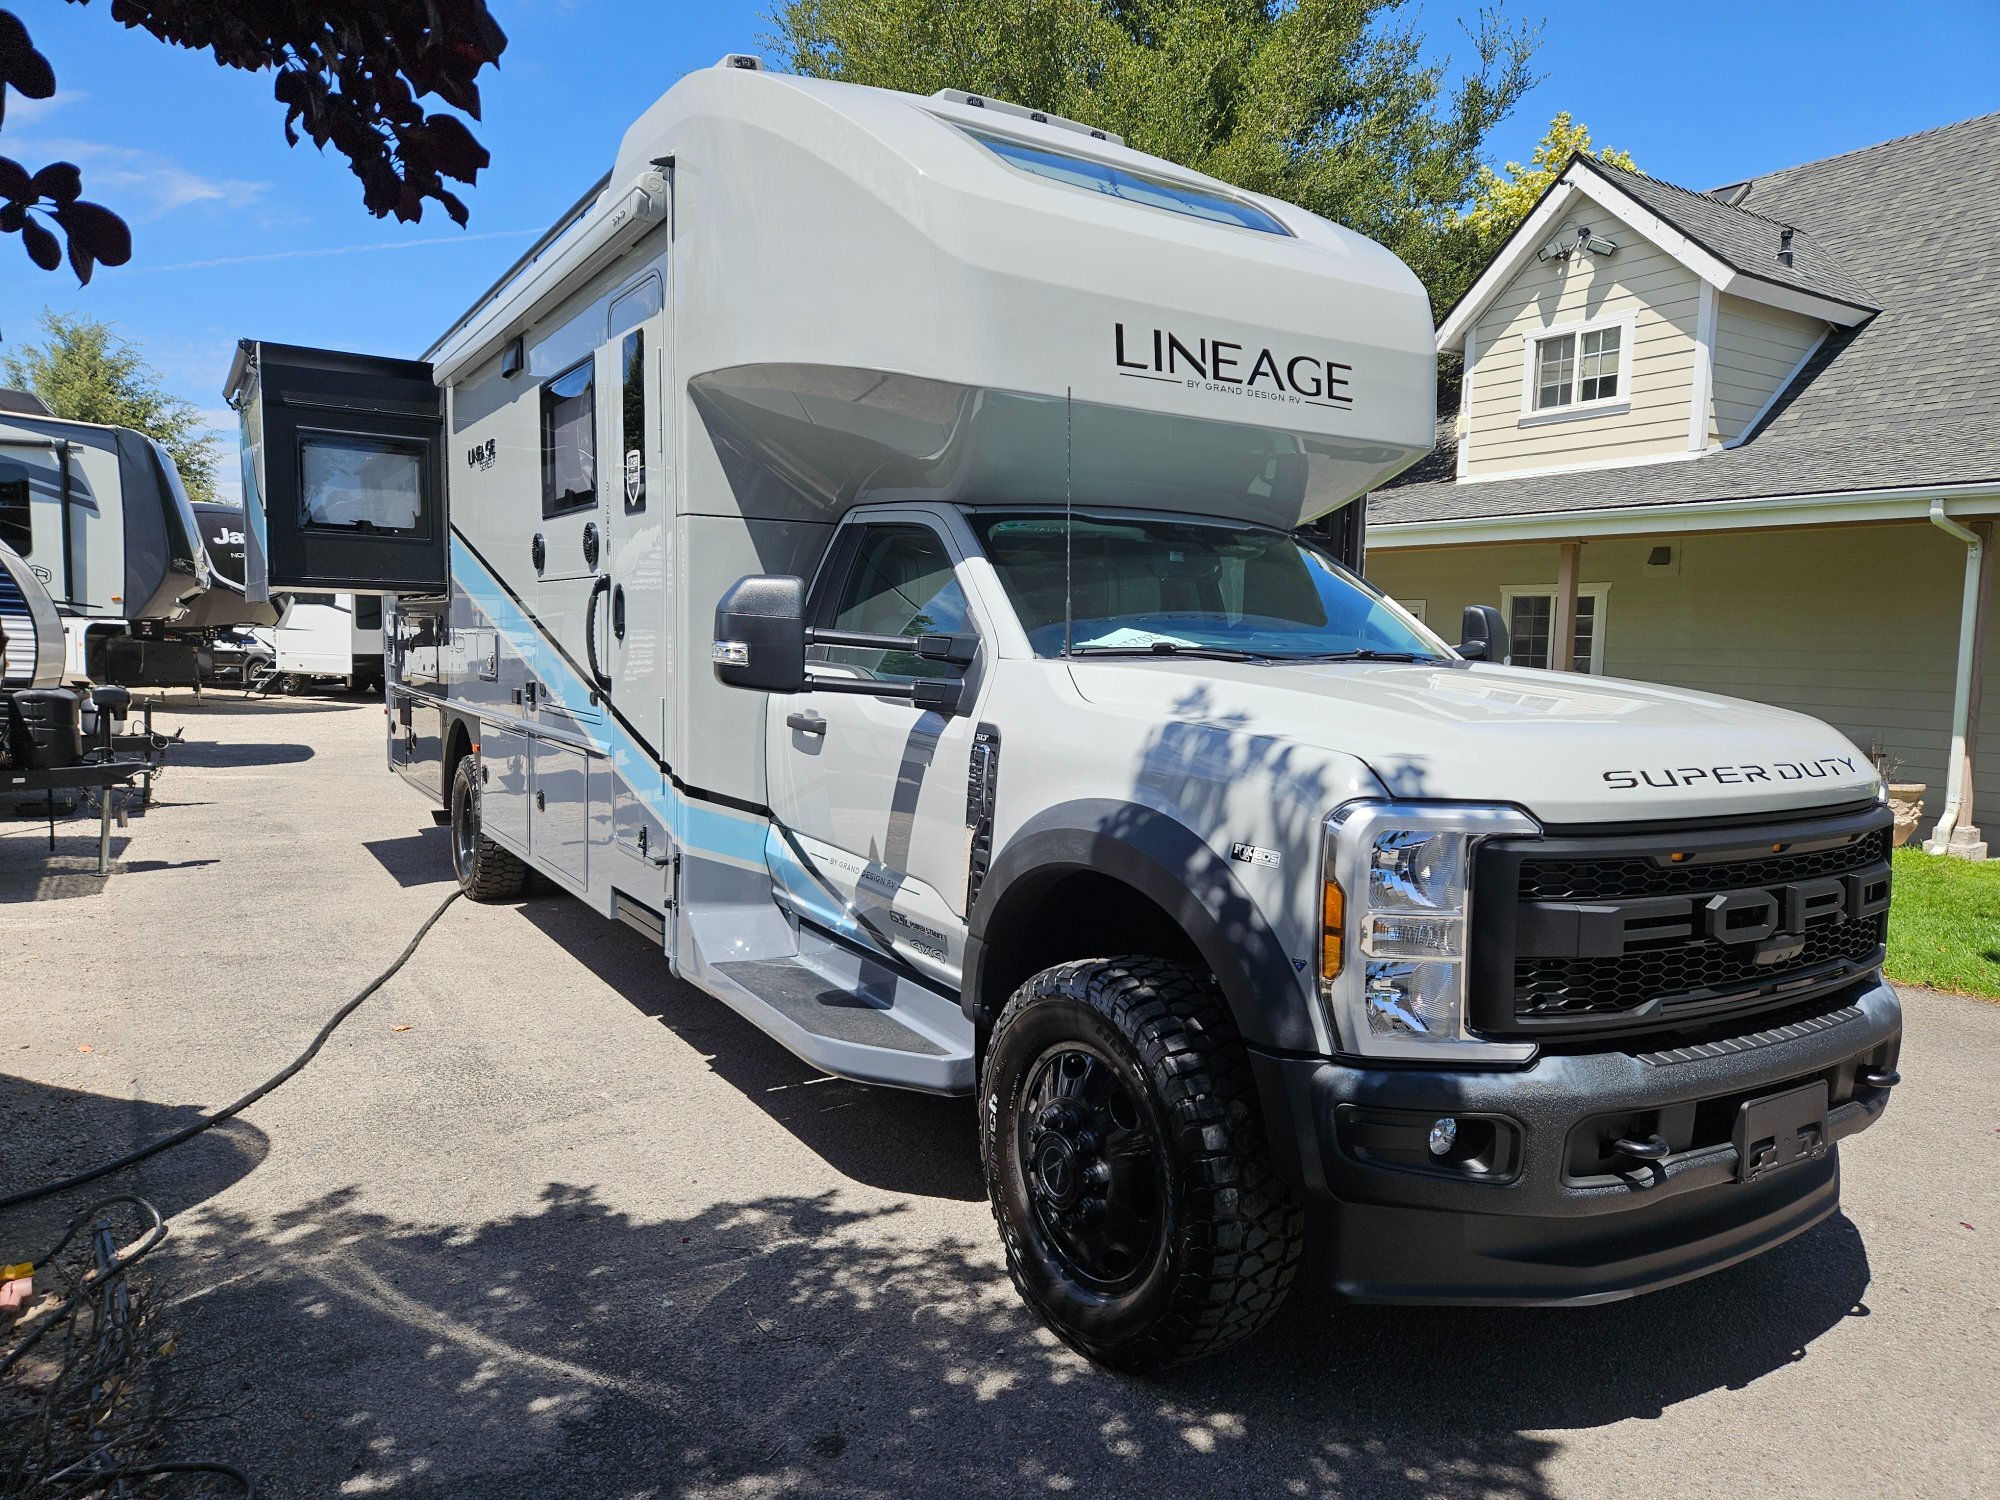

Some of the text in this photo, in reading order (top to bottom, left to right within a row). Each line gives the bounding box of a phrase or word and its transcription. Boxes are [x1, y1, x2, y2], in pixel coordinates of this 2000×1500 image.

[1115, 323, 1353, 403] LINEAGE
[1187, 380, 1301, 404] BY GRAND DESIGN RV
[975, 733, 990, 742] XLT
[1602, 757, 1856, 789] SUPER DUTY
[829, 857, 896, 889] BY GRAND DESIGN RV
[1577, 872, 1892, 958] FORD
